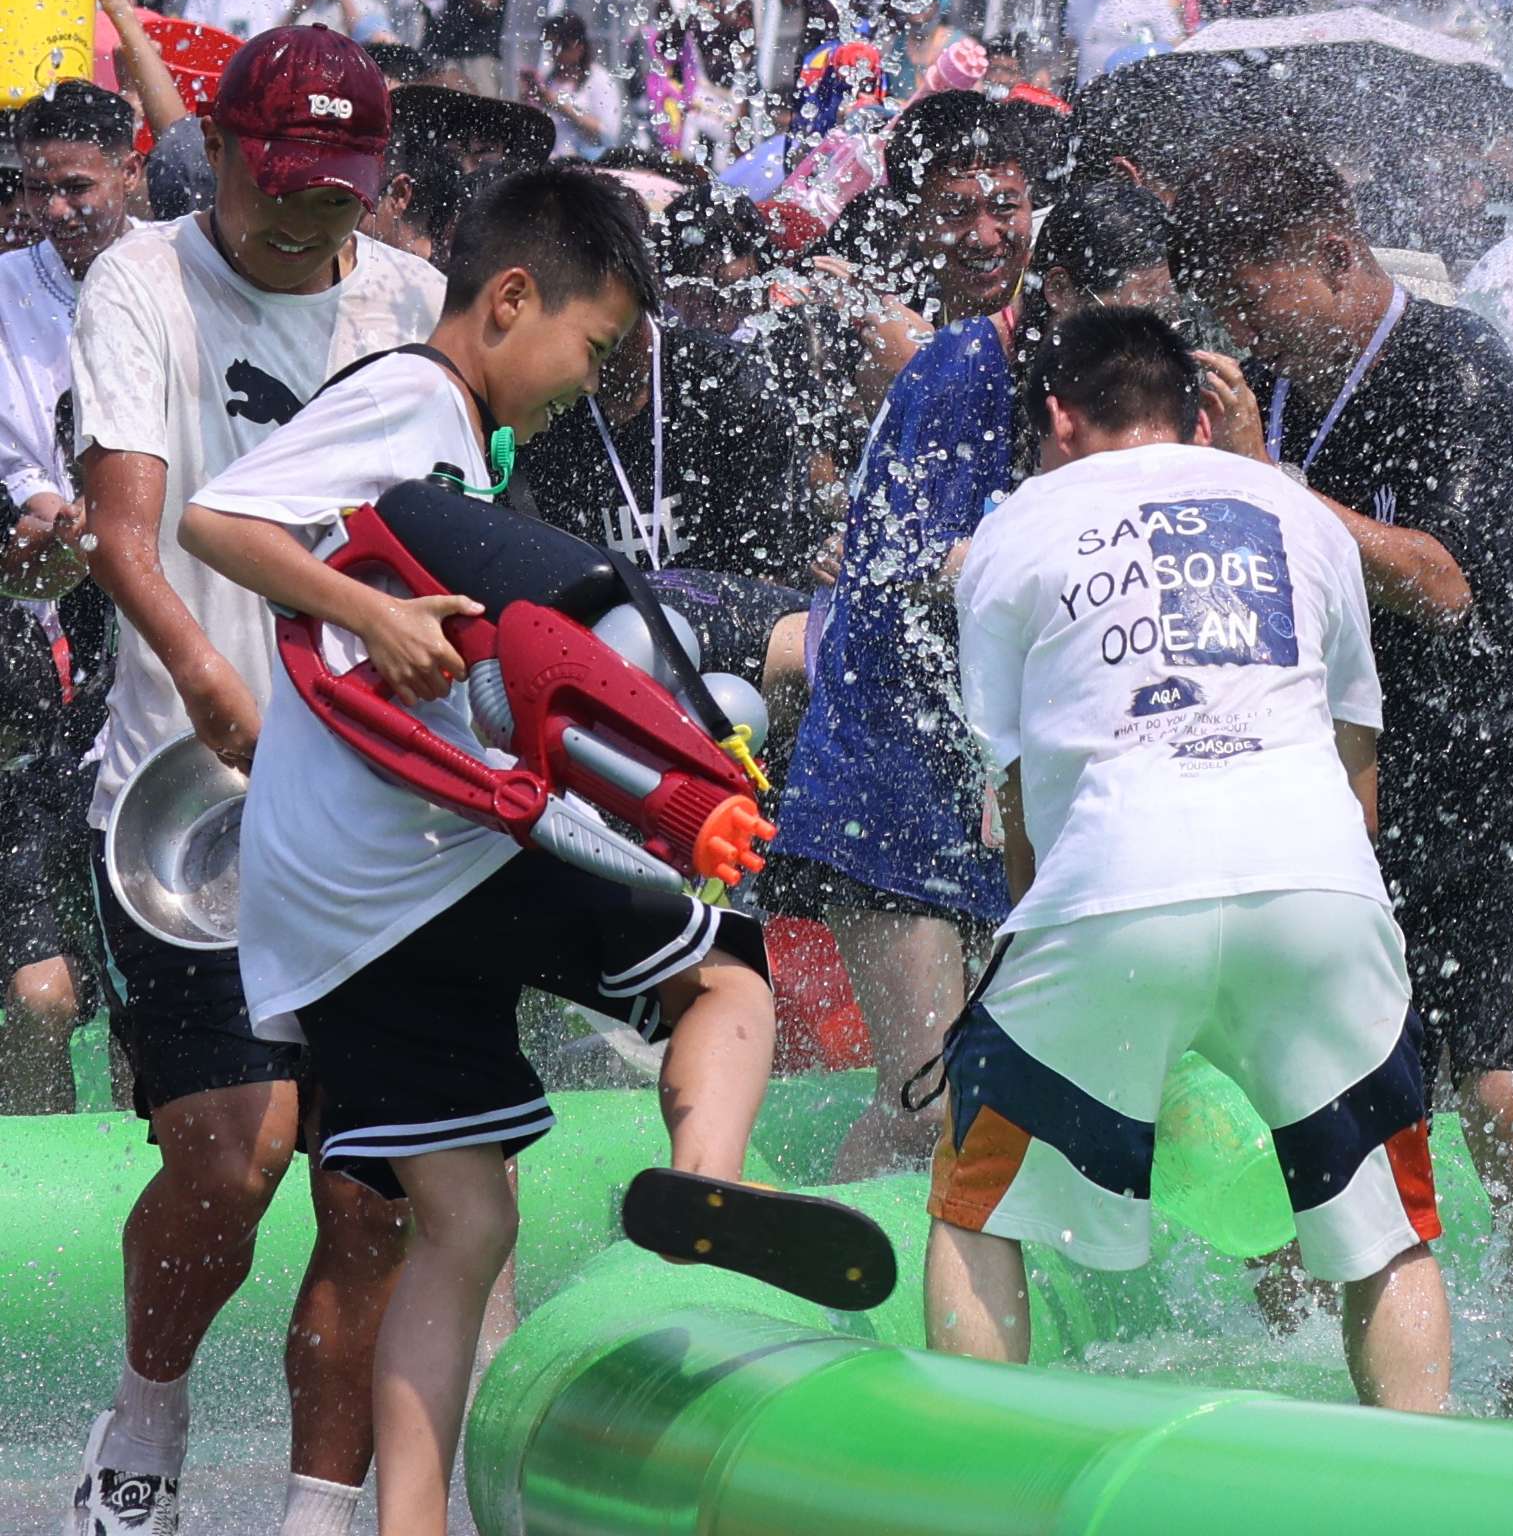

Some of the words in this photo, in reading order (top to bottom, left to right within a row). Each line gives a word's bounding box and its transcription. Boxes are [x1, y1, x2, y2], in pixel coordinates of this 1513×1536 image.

[308, 94, 353, 119] 1949
[1077, 507, 1207, 556] SAAS
[1060, 552, 1278, 622] YOASOBE
[1150, 687, 1182, 705] AQA
[1146, 718, 1161, 730] DO
